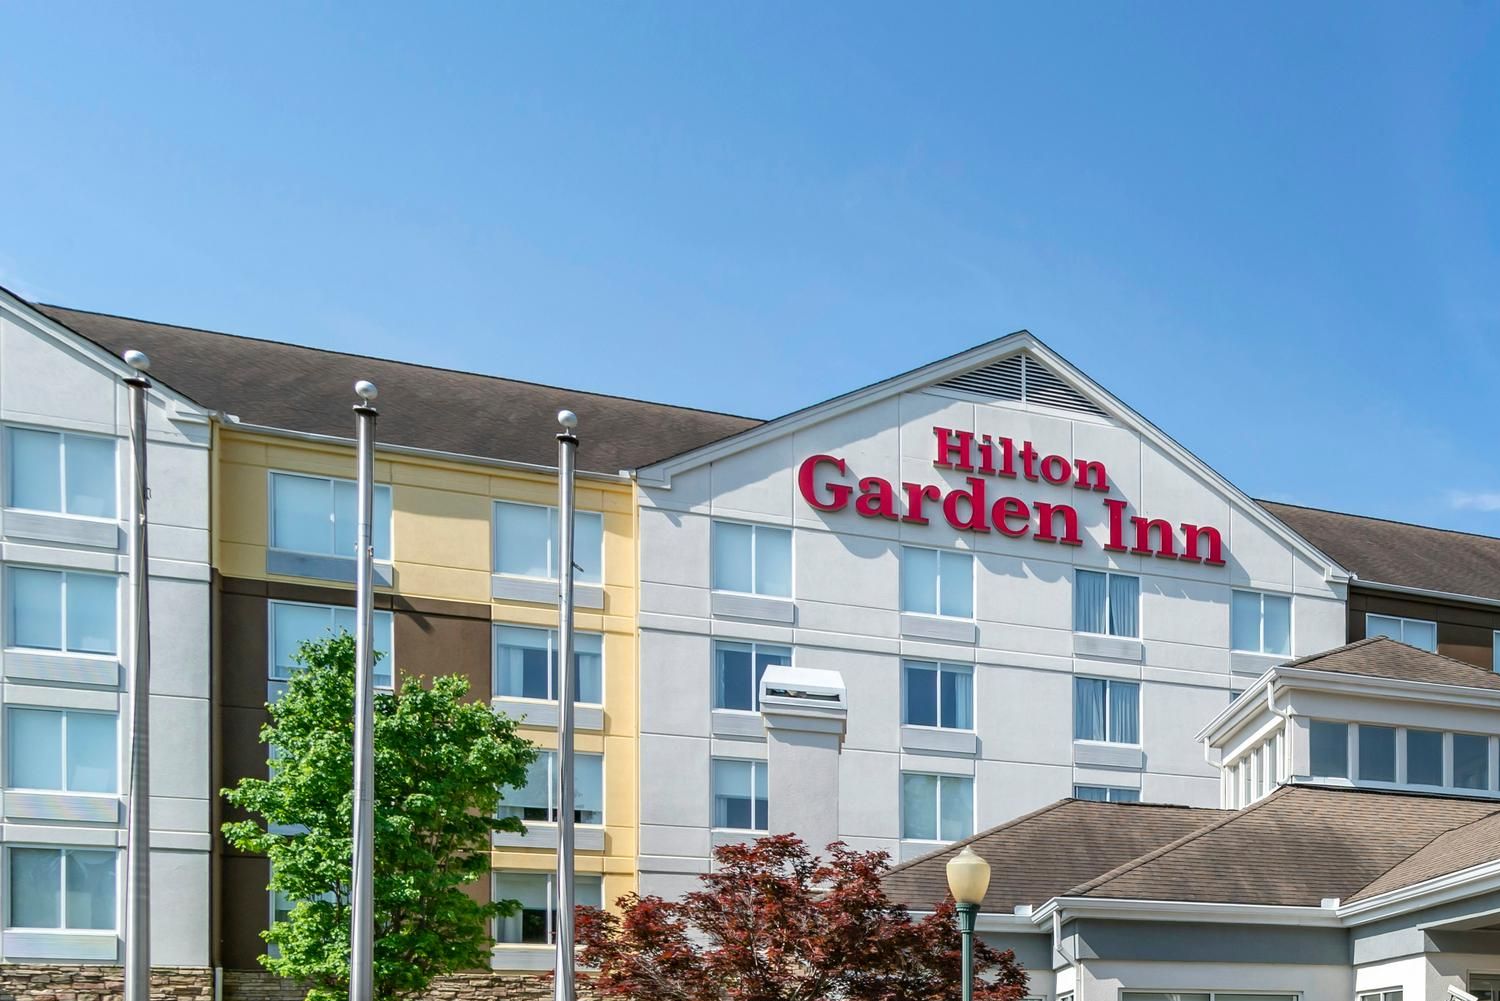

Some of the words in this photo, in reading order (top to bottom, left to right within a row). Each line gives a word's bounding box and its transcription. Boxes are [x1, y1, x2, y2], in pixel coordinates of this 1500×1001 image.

[933, 426, 1111, 492] Hilton
[798, 454, 1083, 546] Garden
[1103, 498, 1227, 566] Inn
